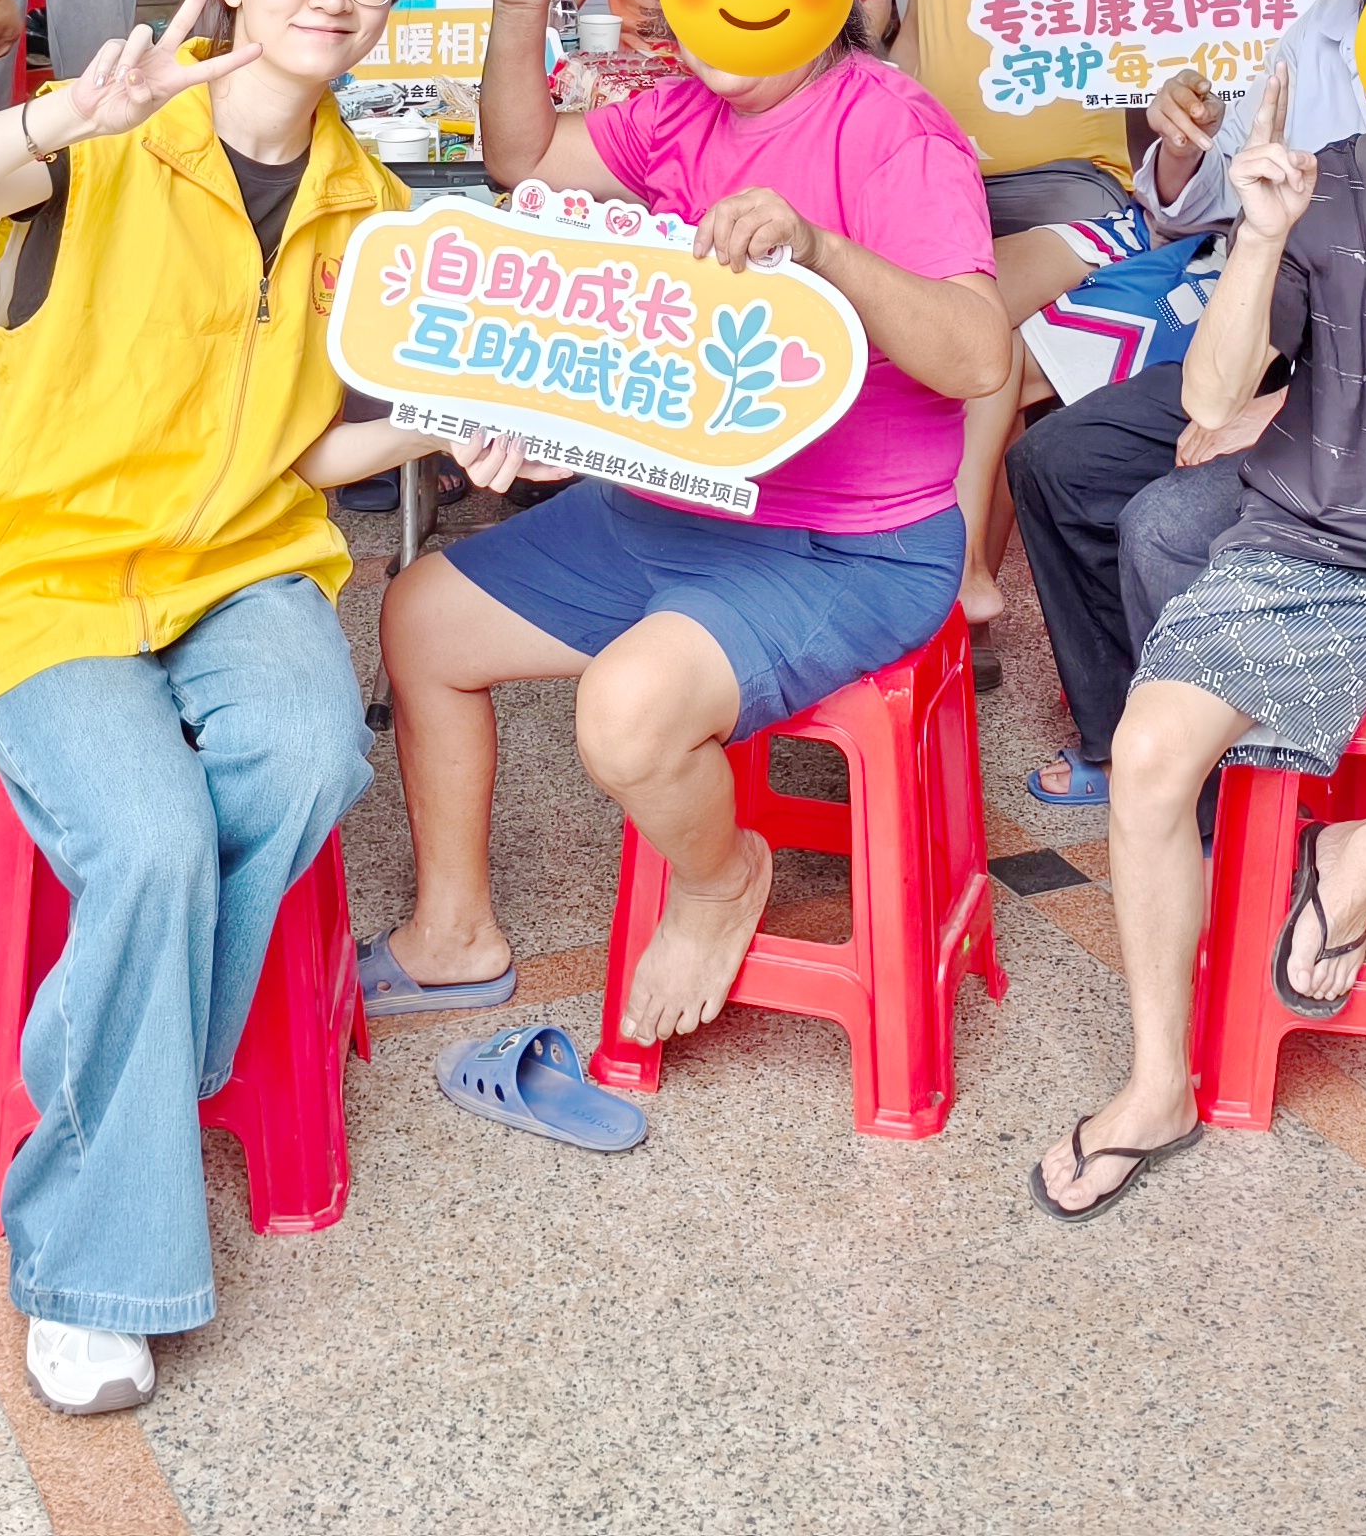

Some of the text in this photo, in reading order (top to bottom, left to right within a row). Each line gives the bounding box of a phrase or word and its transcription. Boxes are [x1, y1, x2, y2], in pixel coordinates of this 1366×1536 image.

[427, 232, 692, 342] 自助成长
[400, 303, 691, 422] 互助赋能
